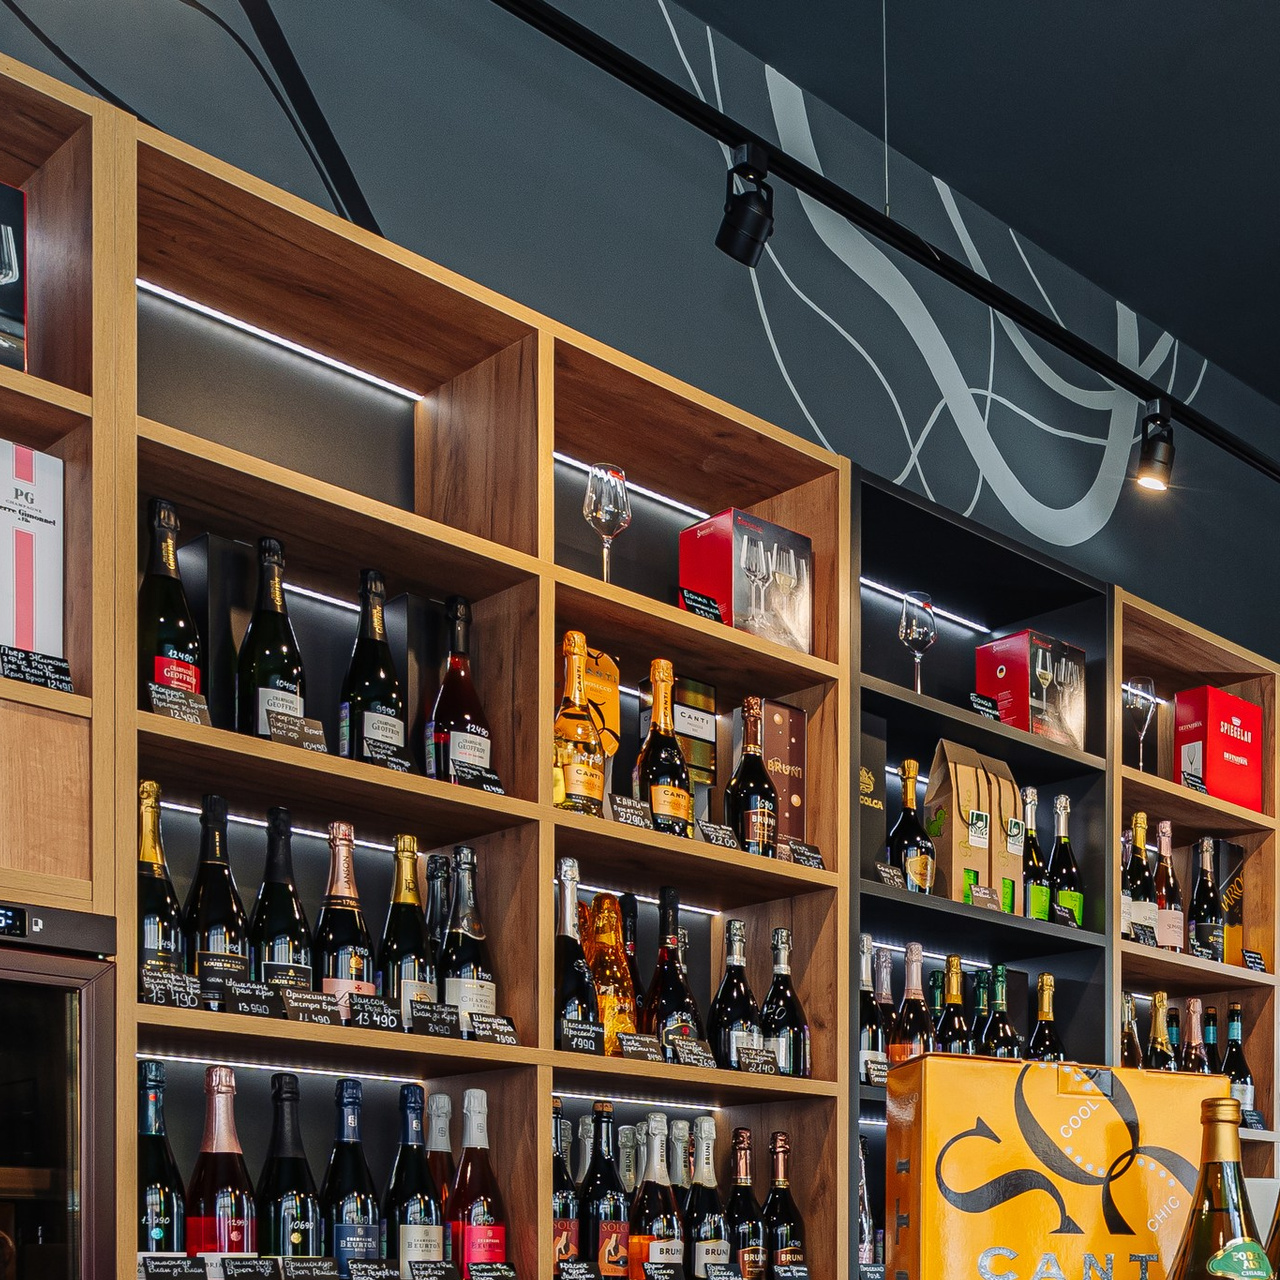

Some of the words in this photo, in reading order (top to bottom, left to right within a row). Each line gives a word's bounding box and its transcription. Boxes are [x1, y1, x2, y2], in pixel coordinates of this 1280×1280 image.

[14, 486, 35, 505] PG
[168, 649, 195, 663] 12490
[47, 679, 74, 693] 12490
[170, 709, 201, 725] 12490
[680, 712, 709, 725] CANTI
[1220, 721, 1252, 743] SPIEGELAU
[767, 758, 802, 779] BRUNI
[663, 789, 688, 801] CANTI
[751, 815, 776, 827] BRUNI
[172, 992, 198, 1007] 490
[355, 1013, 369, 1025] 13
[373, 1014, 397, 1028] 490
[1058, 1096, 1100, 1141] COOL
[1146, 1193, 1182, 1233] CHIC
[340, 1240, 376, 1248] BEURTON
[659, 1247, 682, 1256] BRUNI
[705, 1248, 729, 1256] BRUNI
[744, 1253, 766, 1262] BRUNI
[781, 1254, 803, 1262] BRUNI
